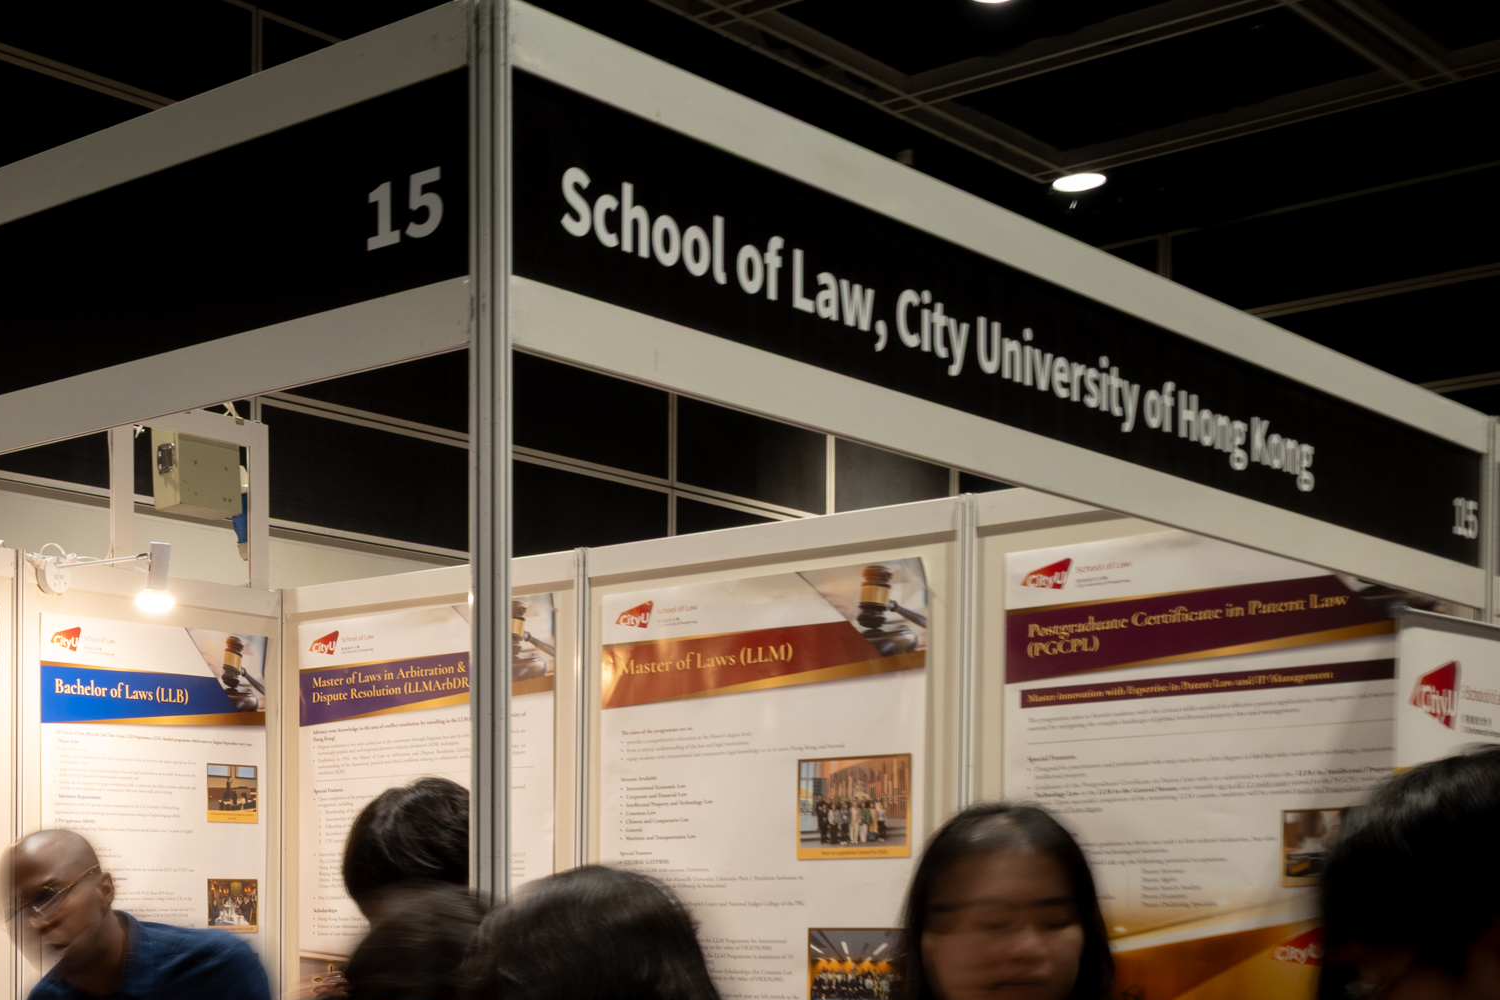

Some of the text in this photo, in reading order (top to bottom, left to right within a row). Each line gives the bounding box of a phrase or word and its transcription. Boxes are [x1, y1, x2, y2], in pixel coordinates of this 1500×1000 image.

[367, 166, 443, 251] 15
[561, 166, 1315, 492] School of Law, City University of Hong Kong
[620, 613, 649, 627] CityU
[1028, 594, 1350, 639] Postgraduate Certificate in Patent Law
[54, 635, 78, 648] CityU
[312, 641, 335, 653] CityU
[341, 635, 357, 643] School
[621, 642, 793, 675] Master of Laws (LLM)
[313, 661, 466, 688] Master of Laws in Arbitration &
[55, 678, 188, 705] Bachelor of Laws (LLB)
[313, 676, 470, 705] Dispute Resolution (LLMArbDR
